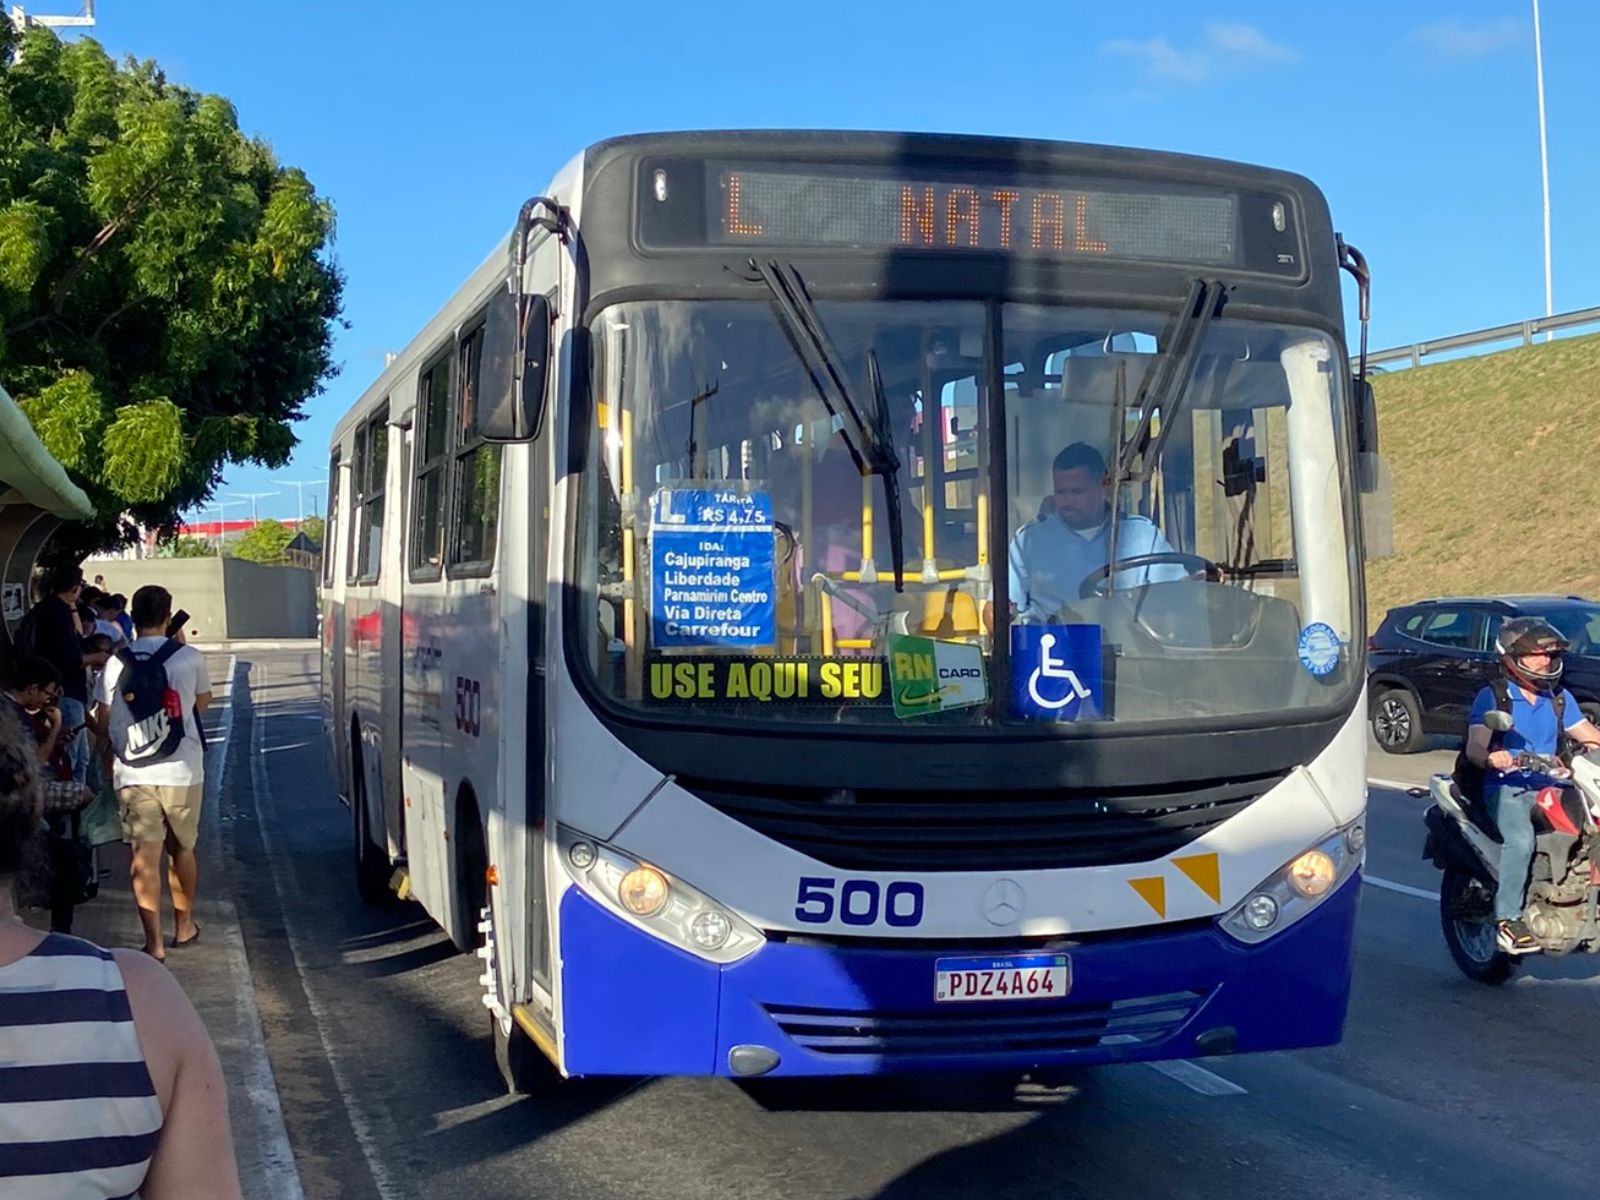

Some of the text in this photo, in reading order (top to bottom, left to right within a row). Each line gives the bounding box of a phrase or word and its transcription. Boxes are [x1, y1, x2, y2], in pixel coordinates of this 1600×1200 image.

[728, 175, 1108, 252] L NATAL
[661, 491, 686, 523] L
[698, 541, 725, 552] IDA:
[664, 552, 750, 570] Cajupiranga
[664, 571, 740, 587] Liberdade
[664, 588, 768, 604] Parnamirim Centro
[664, 605, 742, 620] Via Direta
[664, 622, 761, 637] Carrefour
[894, 652, 981, 680] RN CARD
[650, 662, 883, 701] USE AQUI SEU
[455, 676, 481, 738] 500
[126, 708, 171, 751] NIKE
[794, 876, 925, 927] 500
[949, 970, 1054, 997] PDZ4A64
